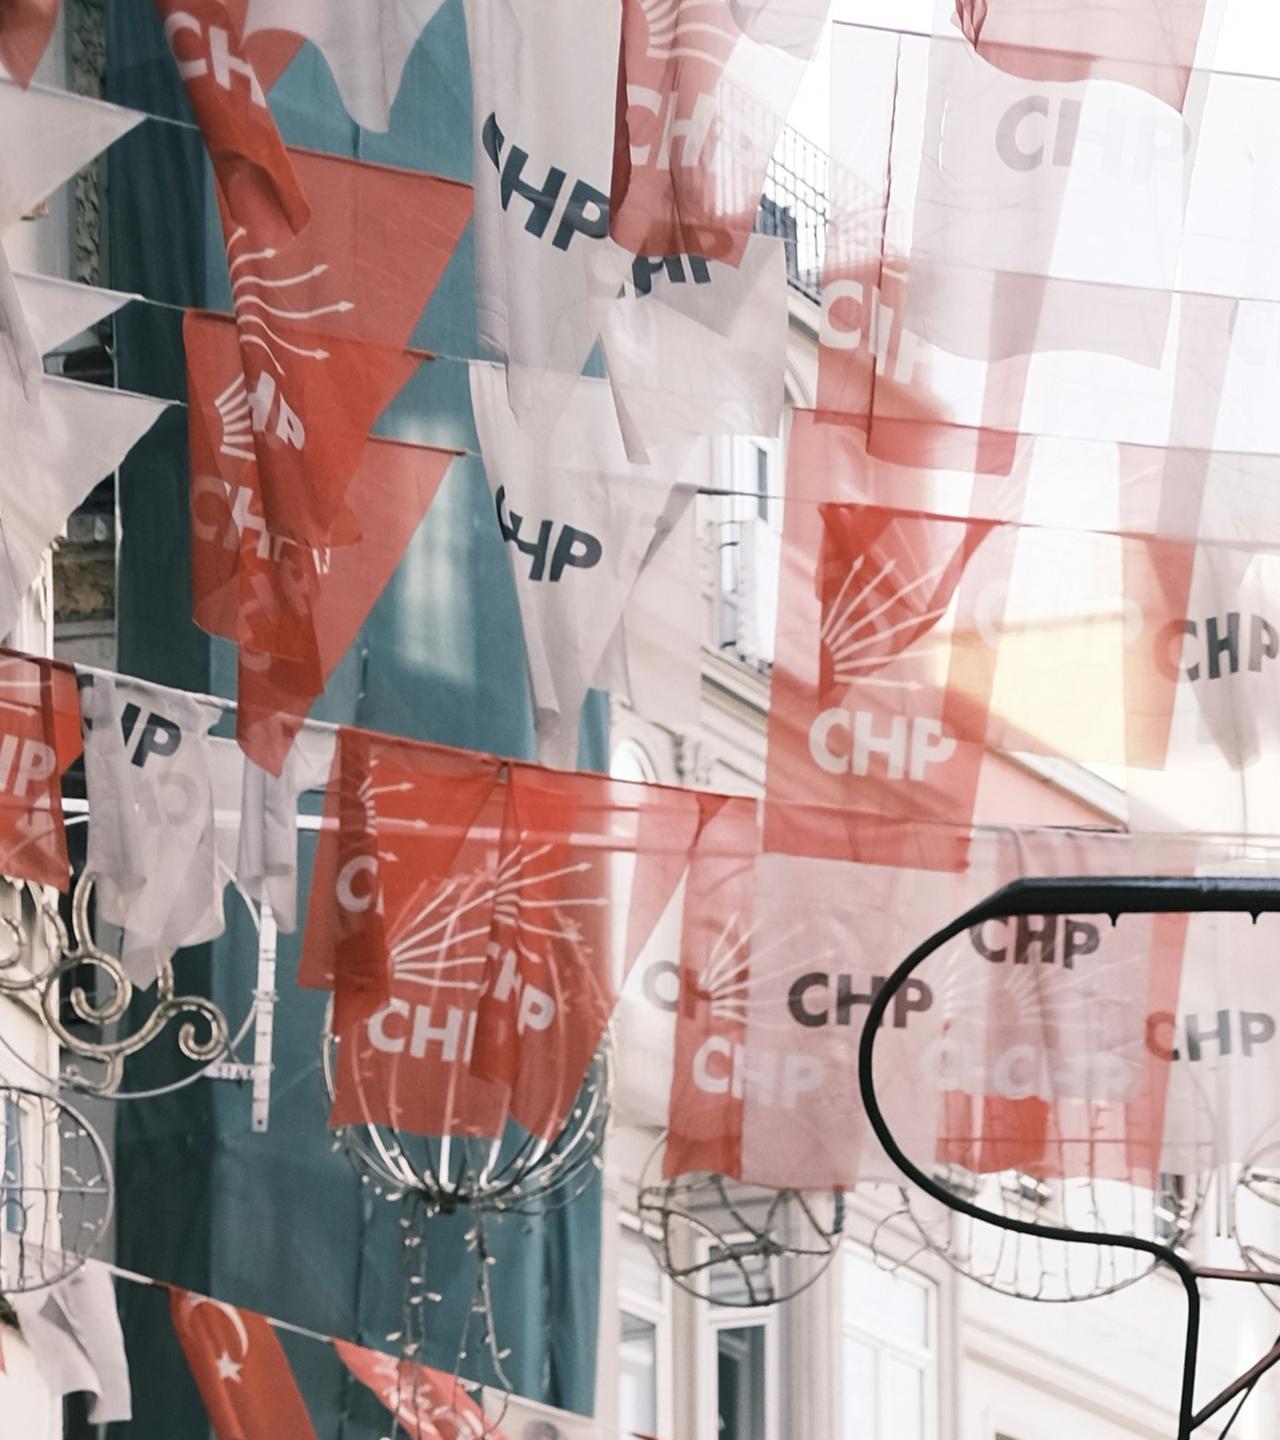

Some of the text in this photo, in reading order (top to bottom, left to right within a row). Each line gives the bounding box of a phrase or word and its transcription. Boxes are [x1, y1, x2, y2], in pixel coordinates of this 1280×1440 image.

[1154, 611, 1280, 682] CHP
[808, 707, 957, 782] CHP
[970, 912, 1101, 969] CHP
[787, 972, 934, 1029] CHP
[1145, 1009, 1276, 1062] CHP
